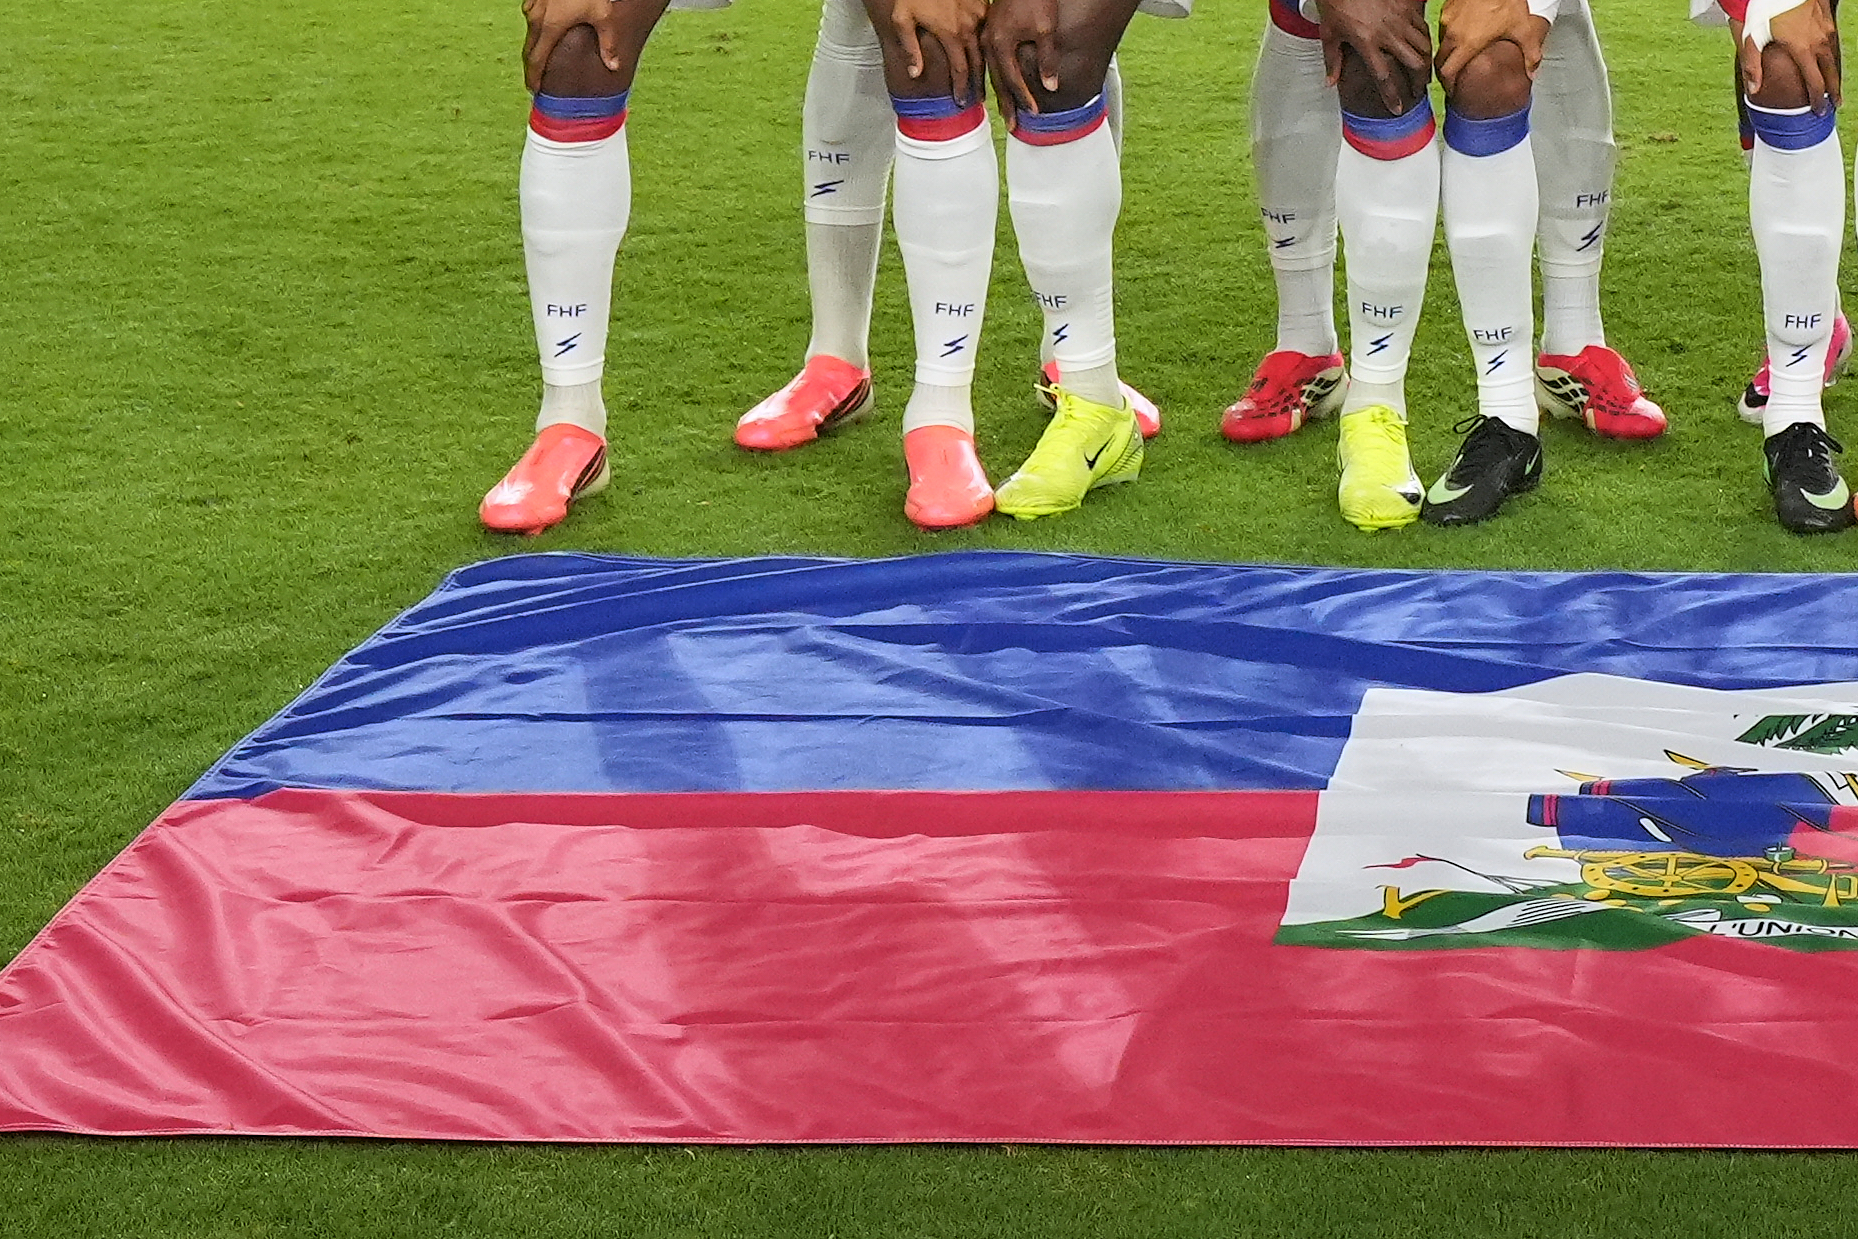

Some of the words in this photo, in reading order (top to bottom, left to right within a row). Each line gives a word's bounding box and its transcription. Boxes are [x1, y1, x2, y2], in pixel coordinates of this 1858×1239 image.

[808, 150, 850, 165] FHF
[547, 304, 587, 317] FHF
[935, 302, 974, 317] FHF
[1362, 302, 1403, 319] FHF
[1785, 313, 1822, 329] FHF
[1473, 326, 1512, 341] FHF
